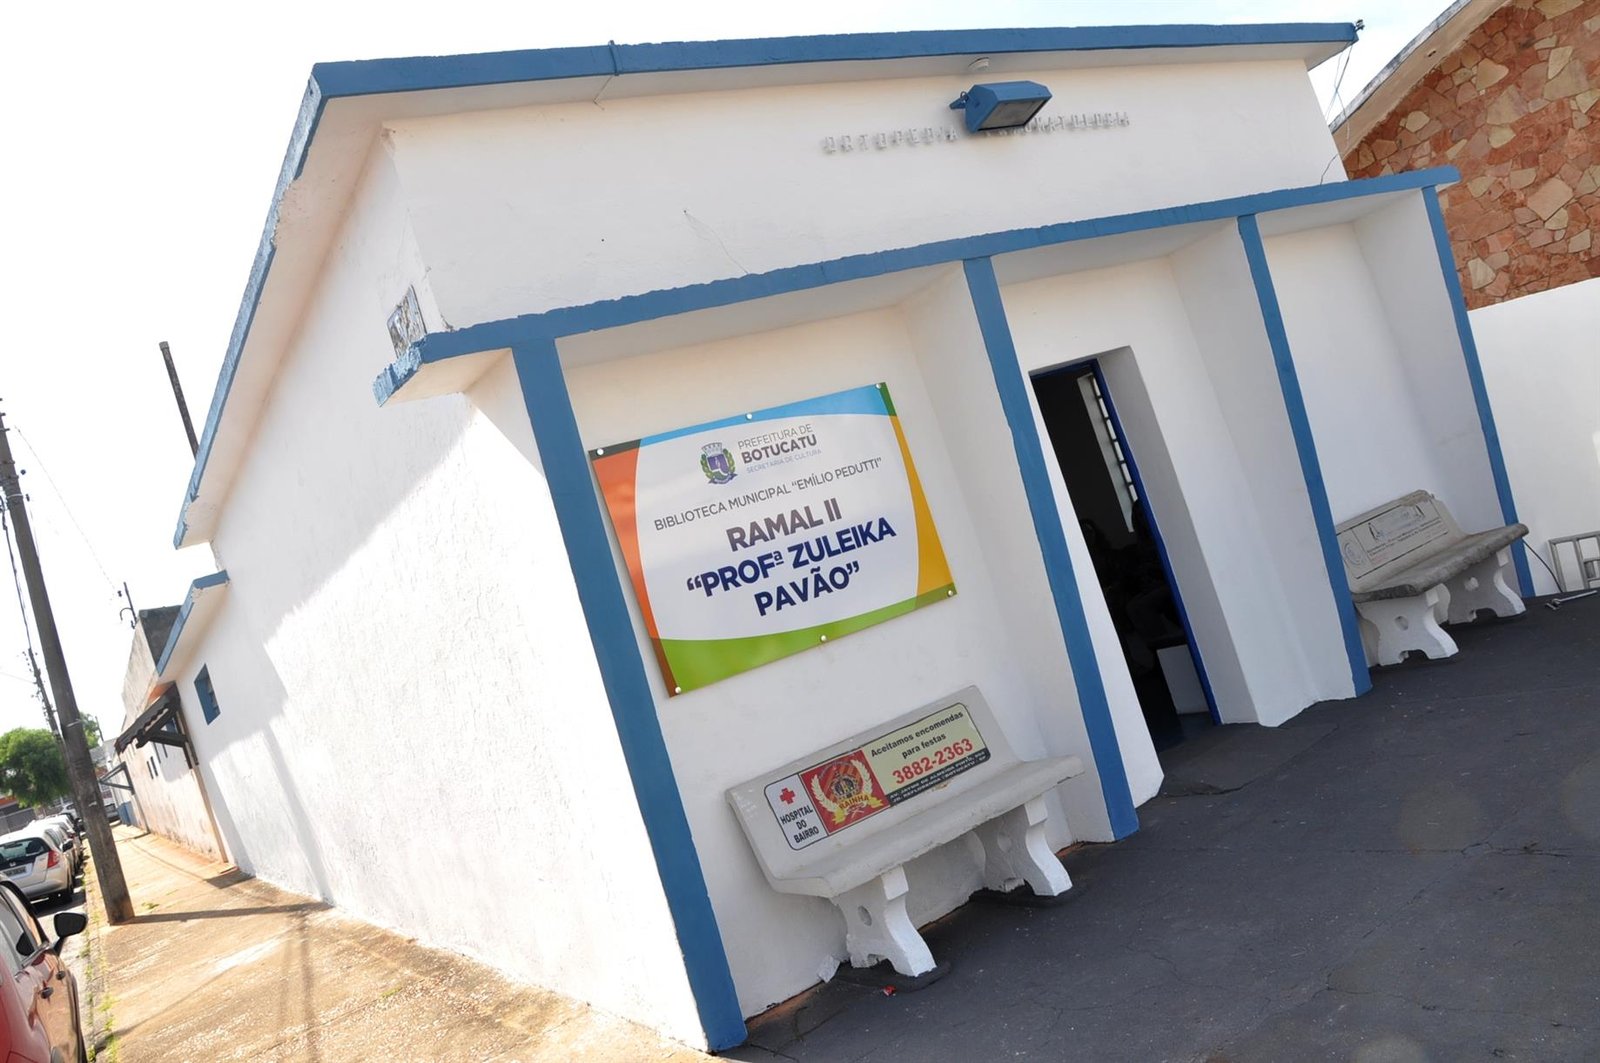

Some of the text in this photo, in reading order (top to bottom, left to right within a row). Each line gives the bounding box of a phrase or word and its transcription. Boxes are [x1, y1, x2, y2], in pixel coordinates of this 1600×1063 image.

[738, 424, 813, 449] PREFEITURA DE
[741, 434, 818, 464] BOTUCATU
[746, 449, 822, 473] SECRETARIA DE CULTURA
[654, 457, 882, 531] BIBLIOTECA MUNICIPAL “EMÍLIO PEDUTTI”
[726, 498, 842, 552] RAMAL II
[788, 517, 897, 569] ZULEIKA
[754, 561, 860, 616] PAVÃO”
[871, 711, 964, 757] Aceitamos encomendas
[902, 732, 947, 759] para festas
[892, 738, 973, 784] 3882-2363
[780, 804, 813, 825] HOSPITAL
[840, 794, 870, 811] RAINHA
[793, 826, 820, 844] BAIRRO
[796, 819, 807, 830] DO
